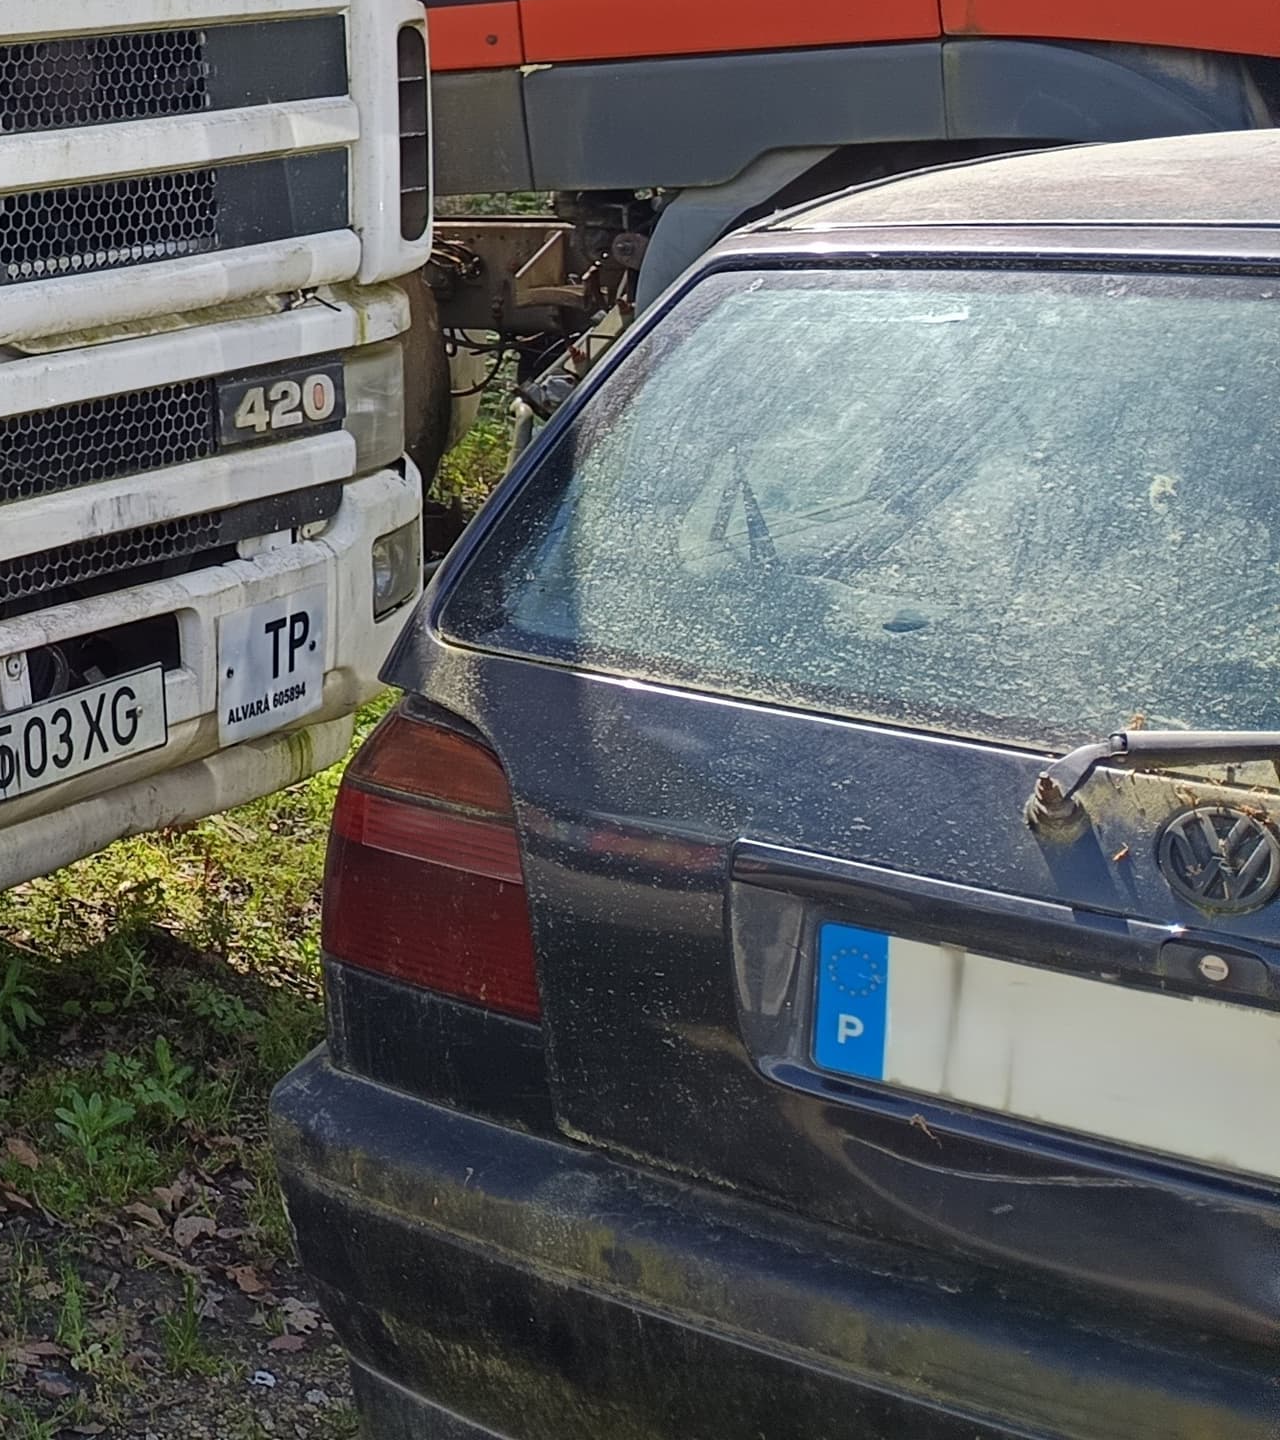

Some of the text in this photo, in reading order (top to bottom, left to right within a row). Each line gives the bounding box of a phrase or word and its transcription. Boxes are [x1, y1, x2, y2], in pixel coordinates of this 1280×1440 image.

[235, 373, 335, 433] 420
[273, 681, 306, 708] 605894
[838, 1014, 864, 1044] P
